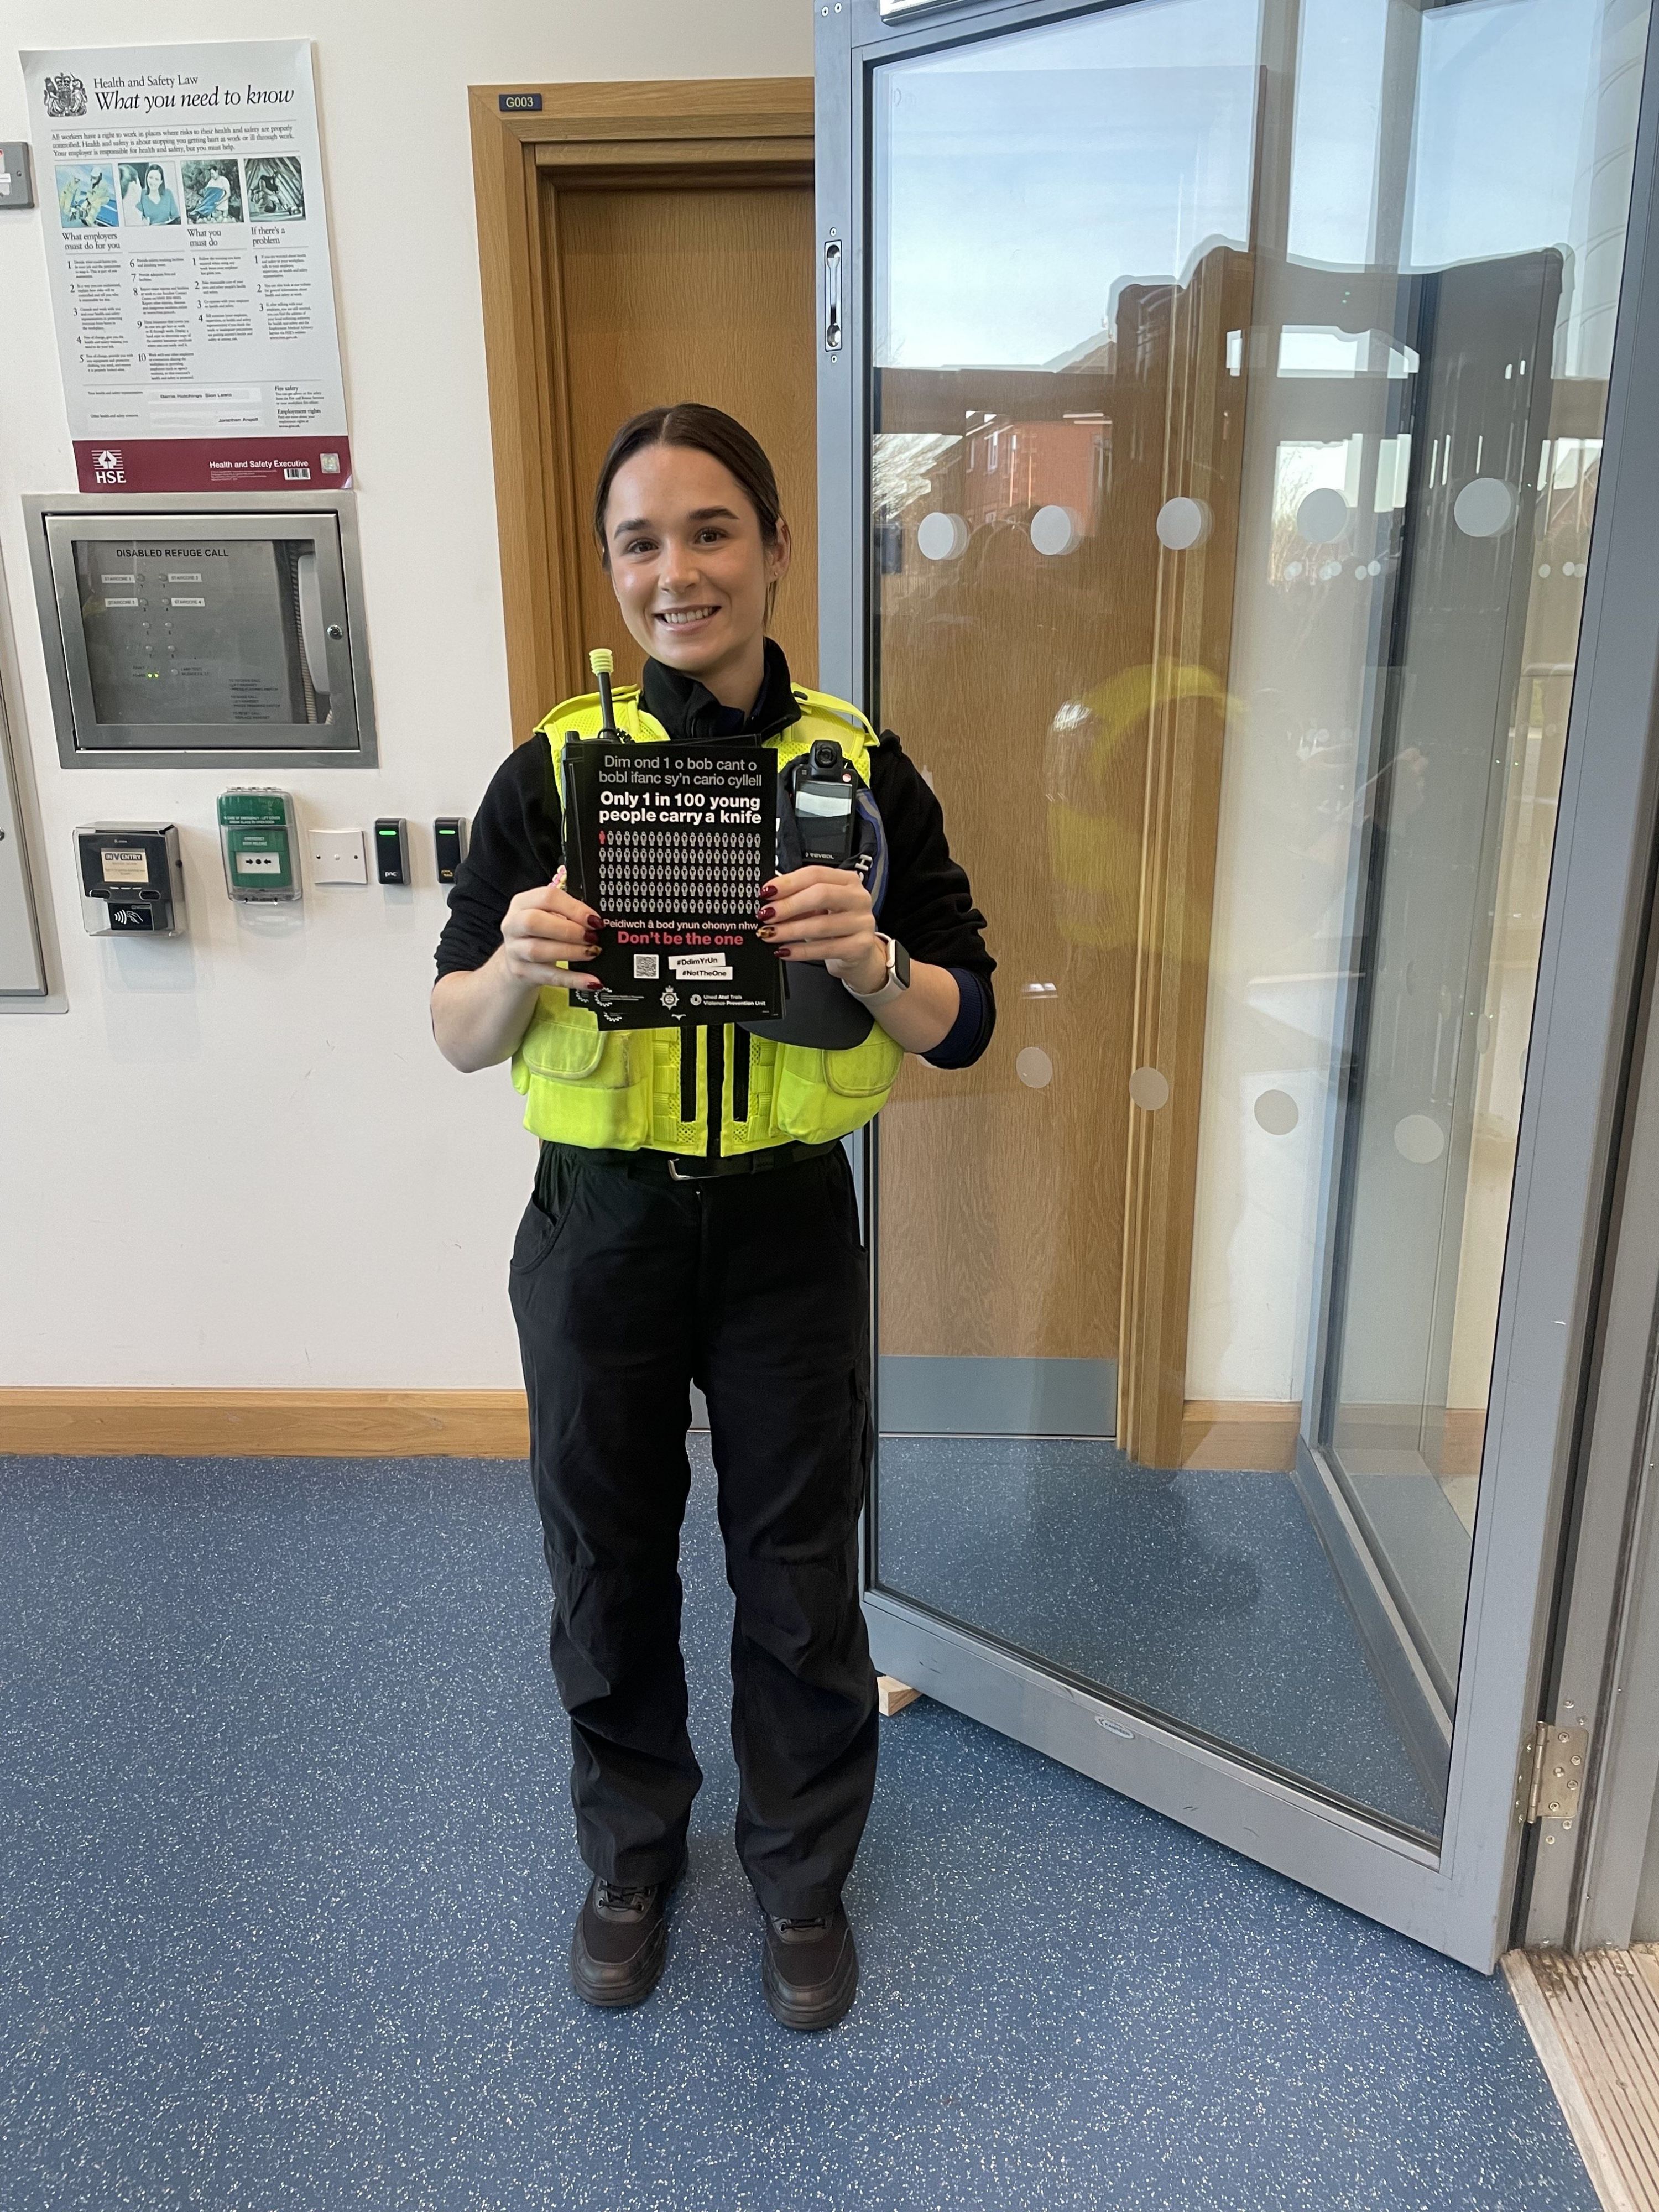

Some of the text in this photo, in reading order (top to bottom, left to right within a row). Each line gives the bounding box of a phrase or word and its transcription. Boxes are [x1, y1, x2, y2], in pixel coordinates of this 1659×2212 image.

[94, 74, 198, 88] Health and Safety Law
[95, 85, 294, 113] What you need to know
[506, 97, 534, 107] G003
[187, 228, 221, 238] What you
[251, 227, 257, 235] If
[259, 226, 279, 234] there's
[62, 231, 117, 242] What employers
[209, 237, 218, 246] do
[253, 236, 280, 247] problem
[108, 242, 121, 251] you
[129, 259, 135, 268] 6
[192, 257, 196, 265] 1
[255, 255, 258, 264] 1
[131, 273, 136, 282] 7
[70, 284, 75, 293] 2
[195, 281, 200, 290] 2
[257, 284, 262, 293] 2
[133, 288, 138, 296] 8
[197, 300, 202, 309] 3
[259, 304, 264, 312] 3
[198, 314, 203, 322] 4
[137, 320, 142, 329] 9
[76, 336, 81, 344] 4
[80, 354, 84, 363] 5
[138, 353, 147, 362] 10
[249, 460, 272, 468] Safety
[95, 471, 126, 484] HSE
[604, 755, 757, 771] Dim ond 1 o bob cant o
[599, 771, 628, 783] bobl
[631, 771, 661, 784] ifanc
[693, 773, 724, 785] cario
[728, 774, 761, 789] cyllell
[600, 791, 760, 811] Only 1 in 100 young
[599, 808, 761, 826] people carry a knife
[603, 919, 758, 932] Peidiwch â bod ynun ohonyn nhw
[663, 932, 682, 945] be
[686, 932, 712, 945] the
[714, 935, 743, 945] one
